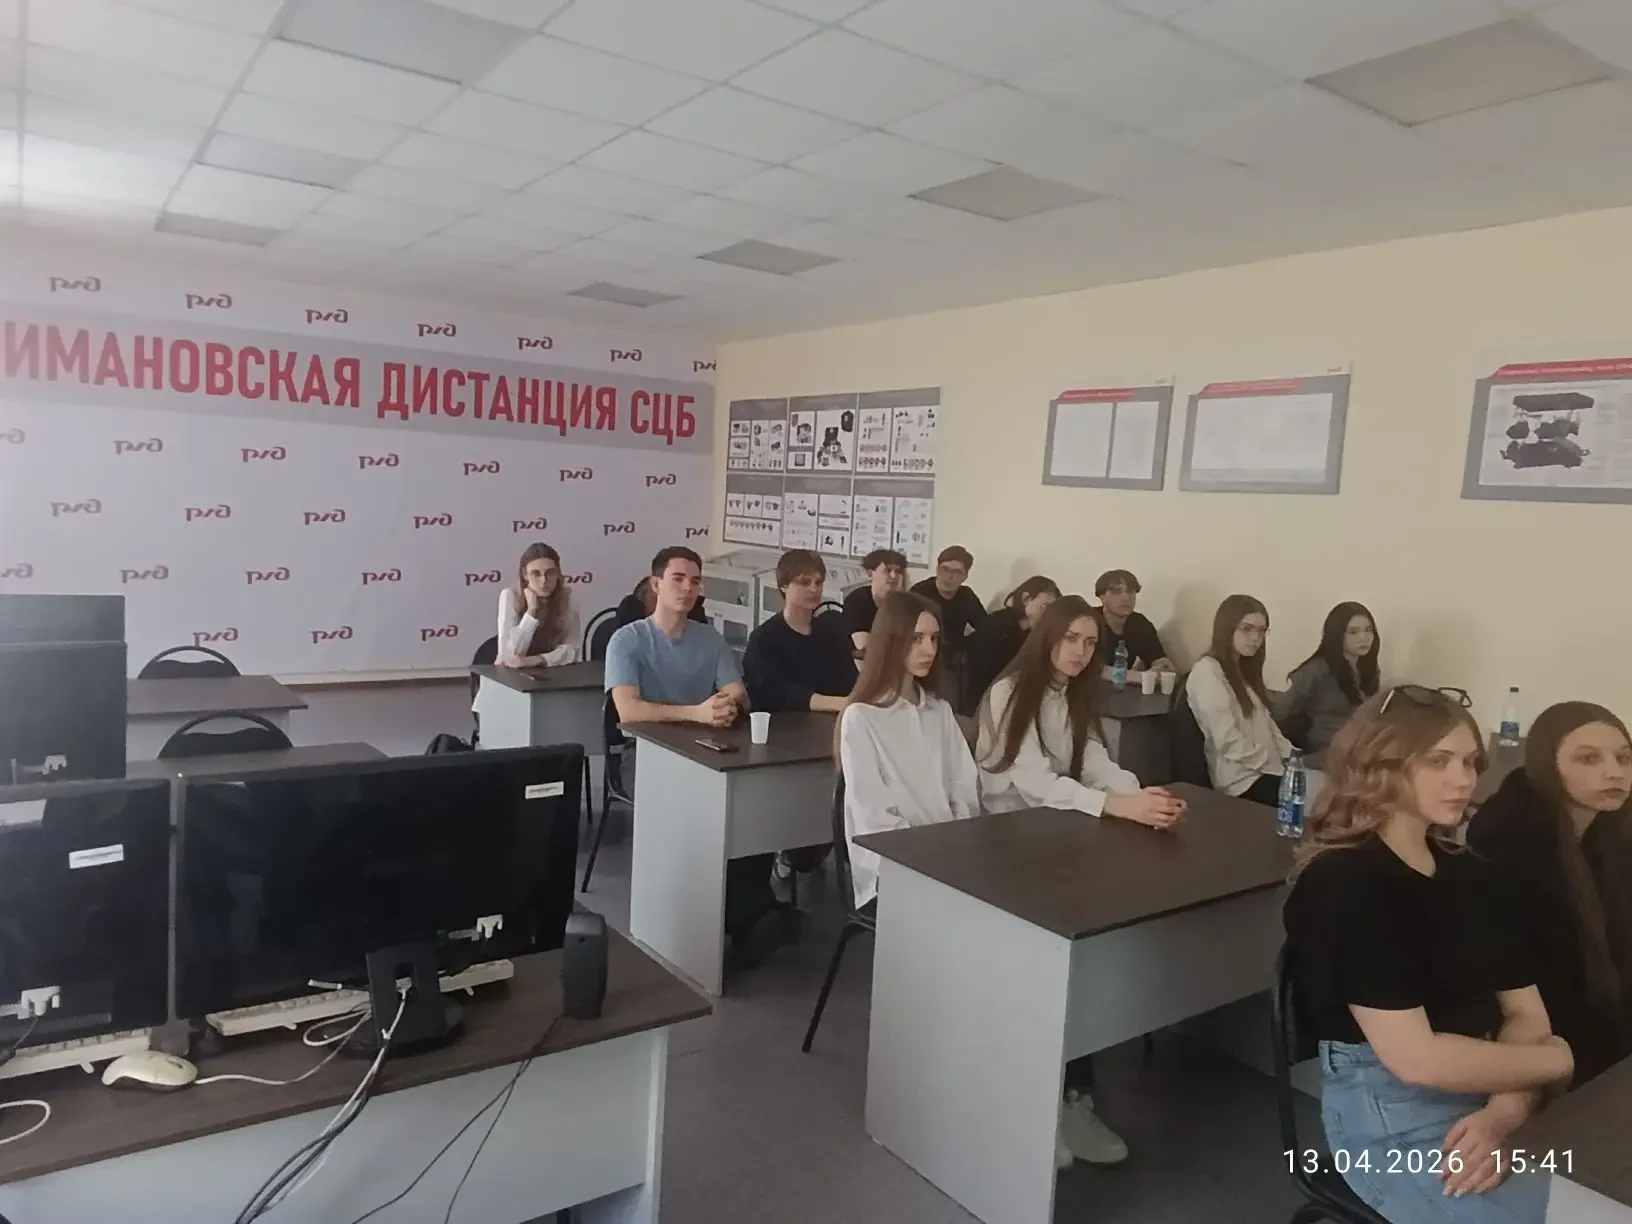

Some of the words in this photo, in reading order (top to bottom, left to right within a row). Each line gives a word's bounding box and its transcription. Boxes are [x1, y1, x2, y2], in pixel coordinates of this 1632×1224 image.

[4, 320, 360, 408] ИМАНОВСКАЯ
[377, 362, 617, 437] ДИСТАНЦИЯ
[630, 390, 696, 445] СЦБ
